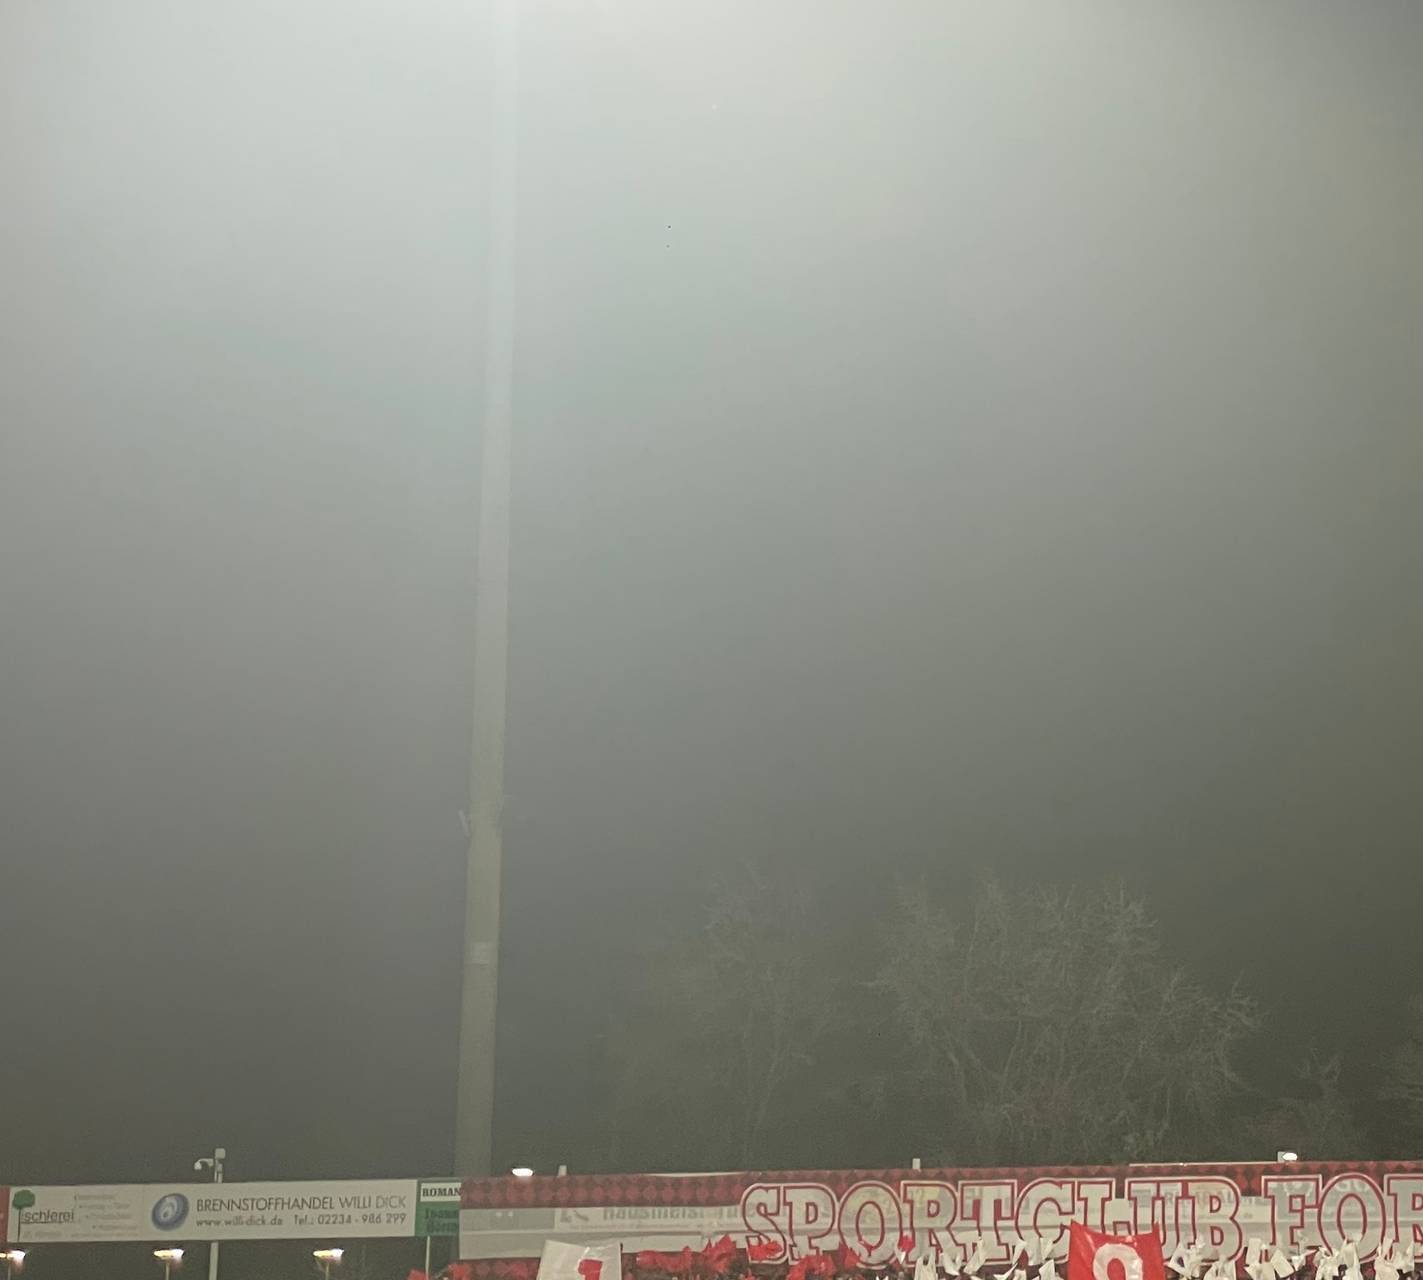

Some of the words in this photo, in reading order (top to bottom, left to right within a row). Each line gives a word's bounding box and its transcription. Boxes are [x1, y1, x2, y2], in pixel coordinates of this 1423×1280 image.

[196, 1196, 335, 1212] BRENNSTOFFHANDEL
[338, 1195, 371, 1210] WILLI
[375, 1194, 407, 1209] DICK
[741, 1176, 1244, 1268] SPORTCLUB
